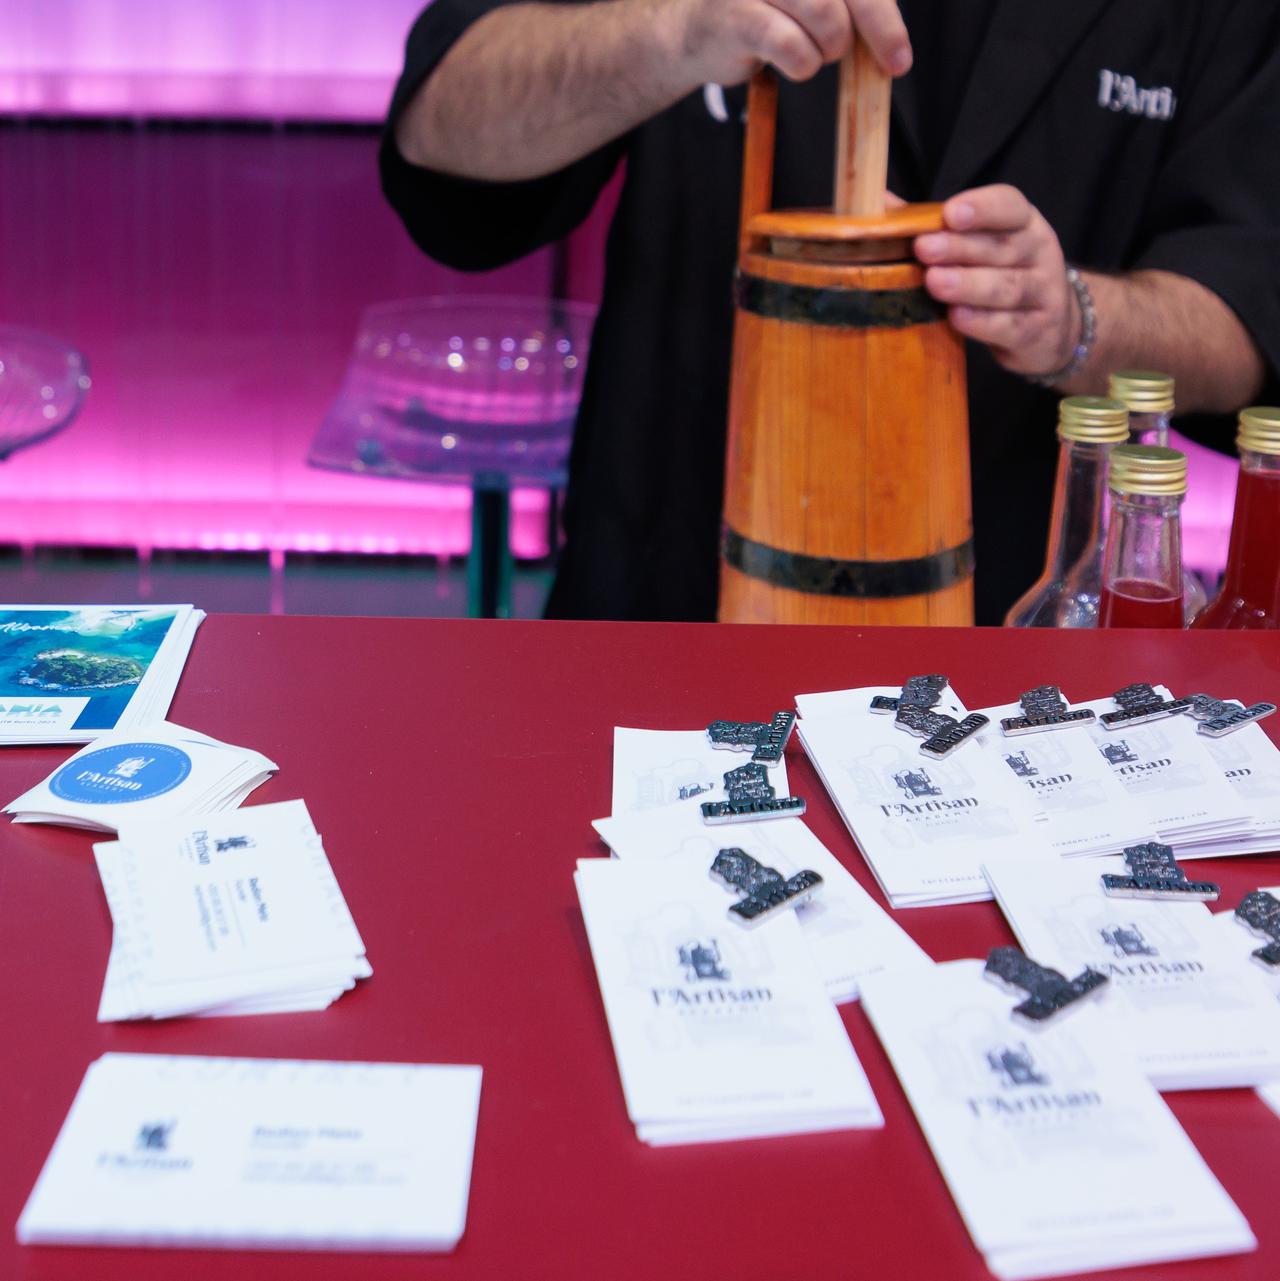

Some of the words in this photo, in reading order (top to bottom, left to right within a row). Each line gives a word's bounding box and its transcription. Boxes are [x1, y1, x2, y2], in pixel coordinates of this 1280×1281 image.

[76, 770, 144, 791] l'Artisan
[881, 796, 979, 818] l'Artisan
[650, 985, 774, 1006] l'Artisan
[966, 1089, 1103, 1119] l'Artisan
